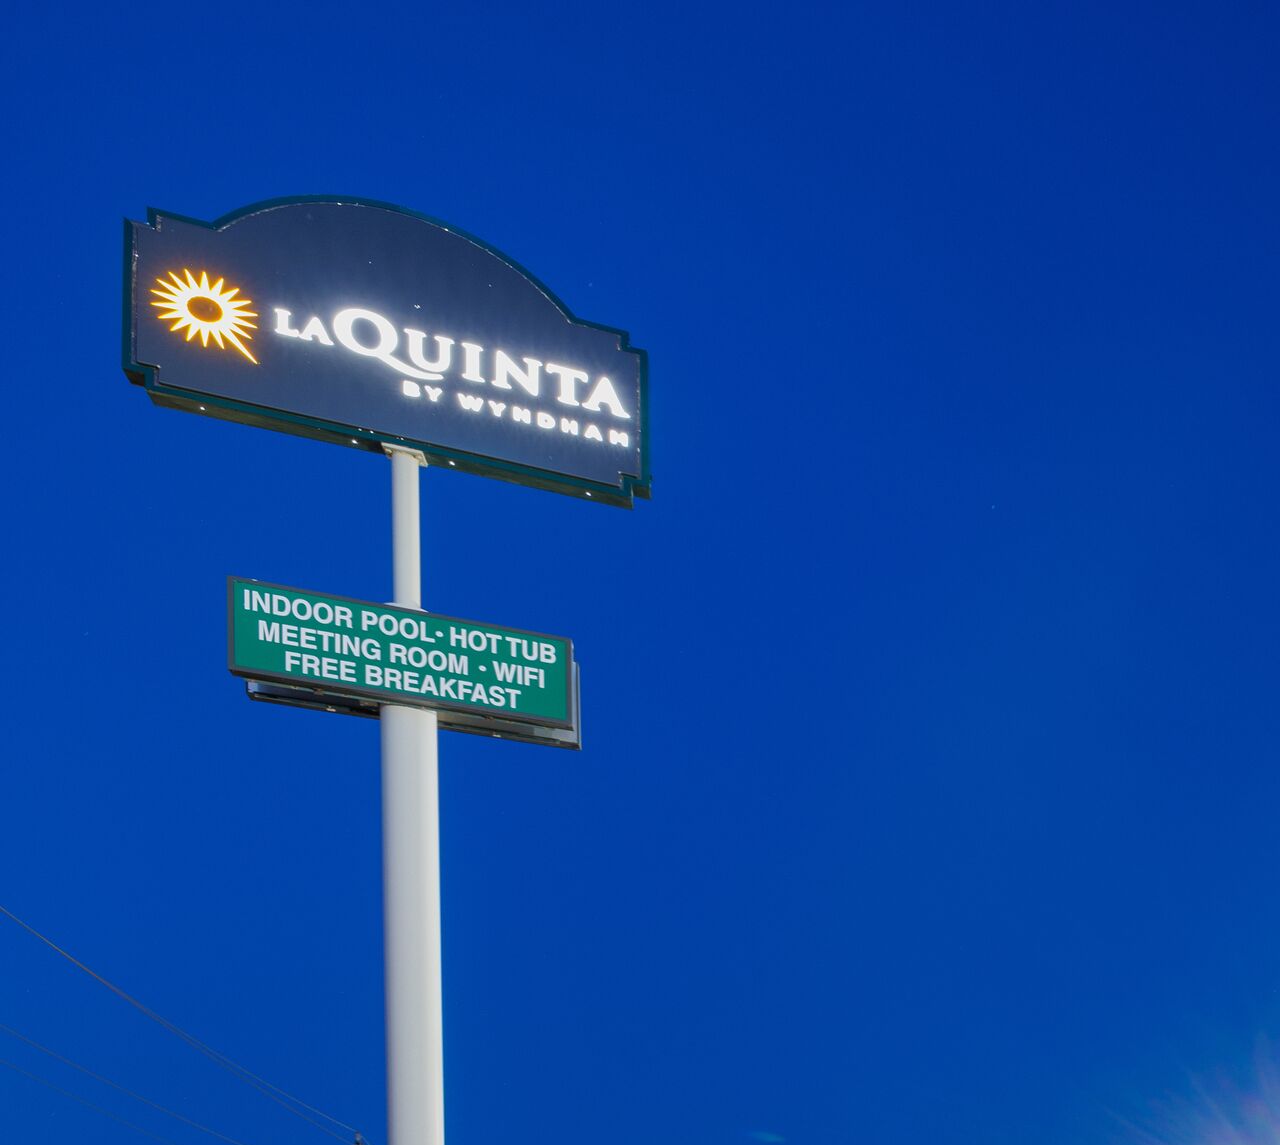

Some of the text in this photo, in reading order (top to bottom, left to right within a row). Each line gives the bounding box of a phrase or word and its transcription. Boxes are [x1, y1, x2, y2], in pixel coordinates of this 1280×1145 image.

[274, 307, 631, 419] LA QUINTA
[402, 380, 629, 448] BY WYNDHAM
[244, 589, 353, 629] INDOOR
[450, 626, 502, 654] HOT
[505, 636, 556, 664] TUB
[257, 619, 545, 689] MEETING ROOM WIFI
[285, 651, 521, 709] FREE BREAKFAST
